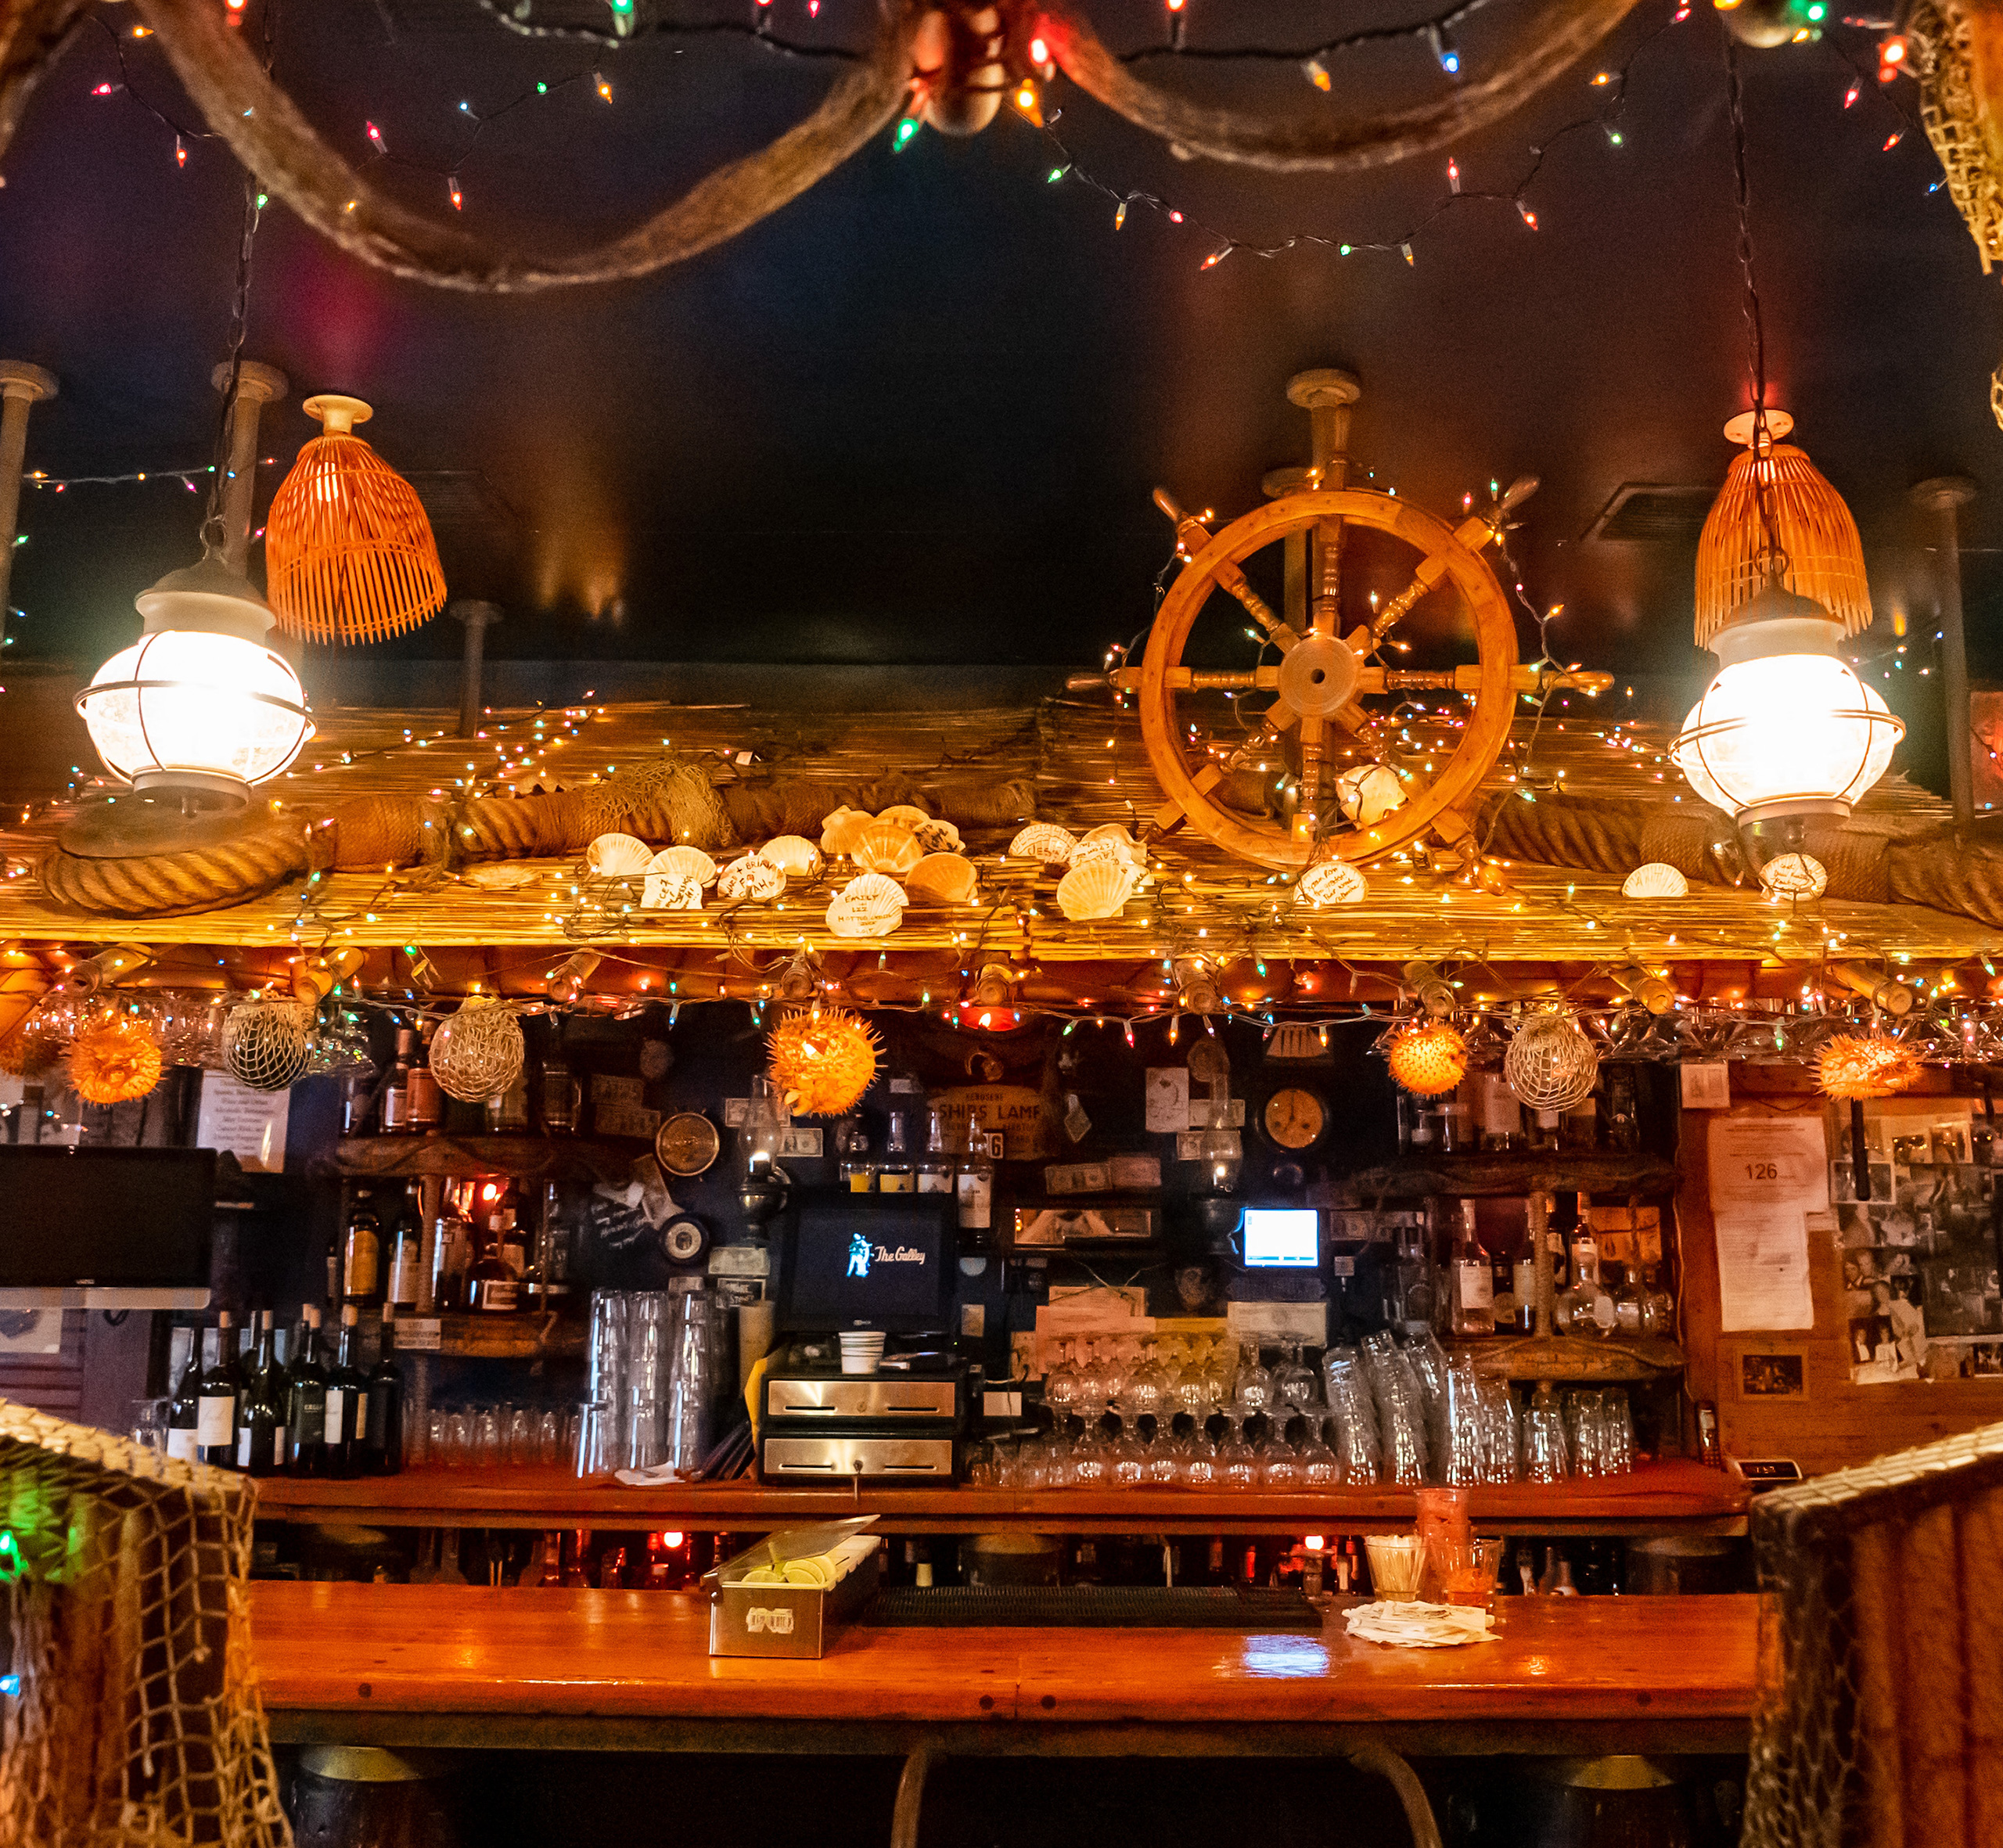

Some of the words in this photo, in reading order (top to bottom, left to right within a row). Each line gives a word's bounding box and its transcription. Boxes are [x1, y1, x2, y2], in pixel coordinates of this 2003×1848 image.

[845, 893, 879, 904] EMILY
[1745, 1163, 1778, 1180] 126
[875, 1246, 895, 1262] The
